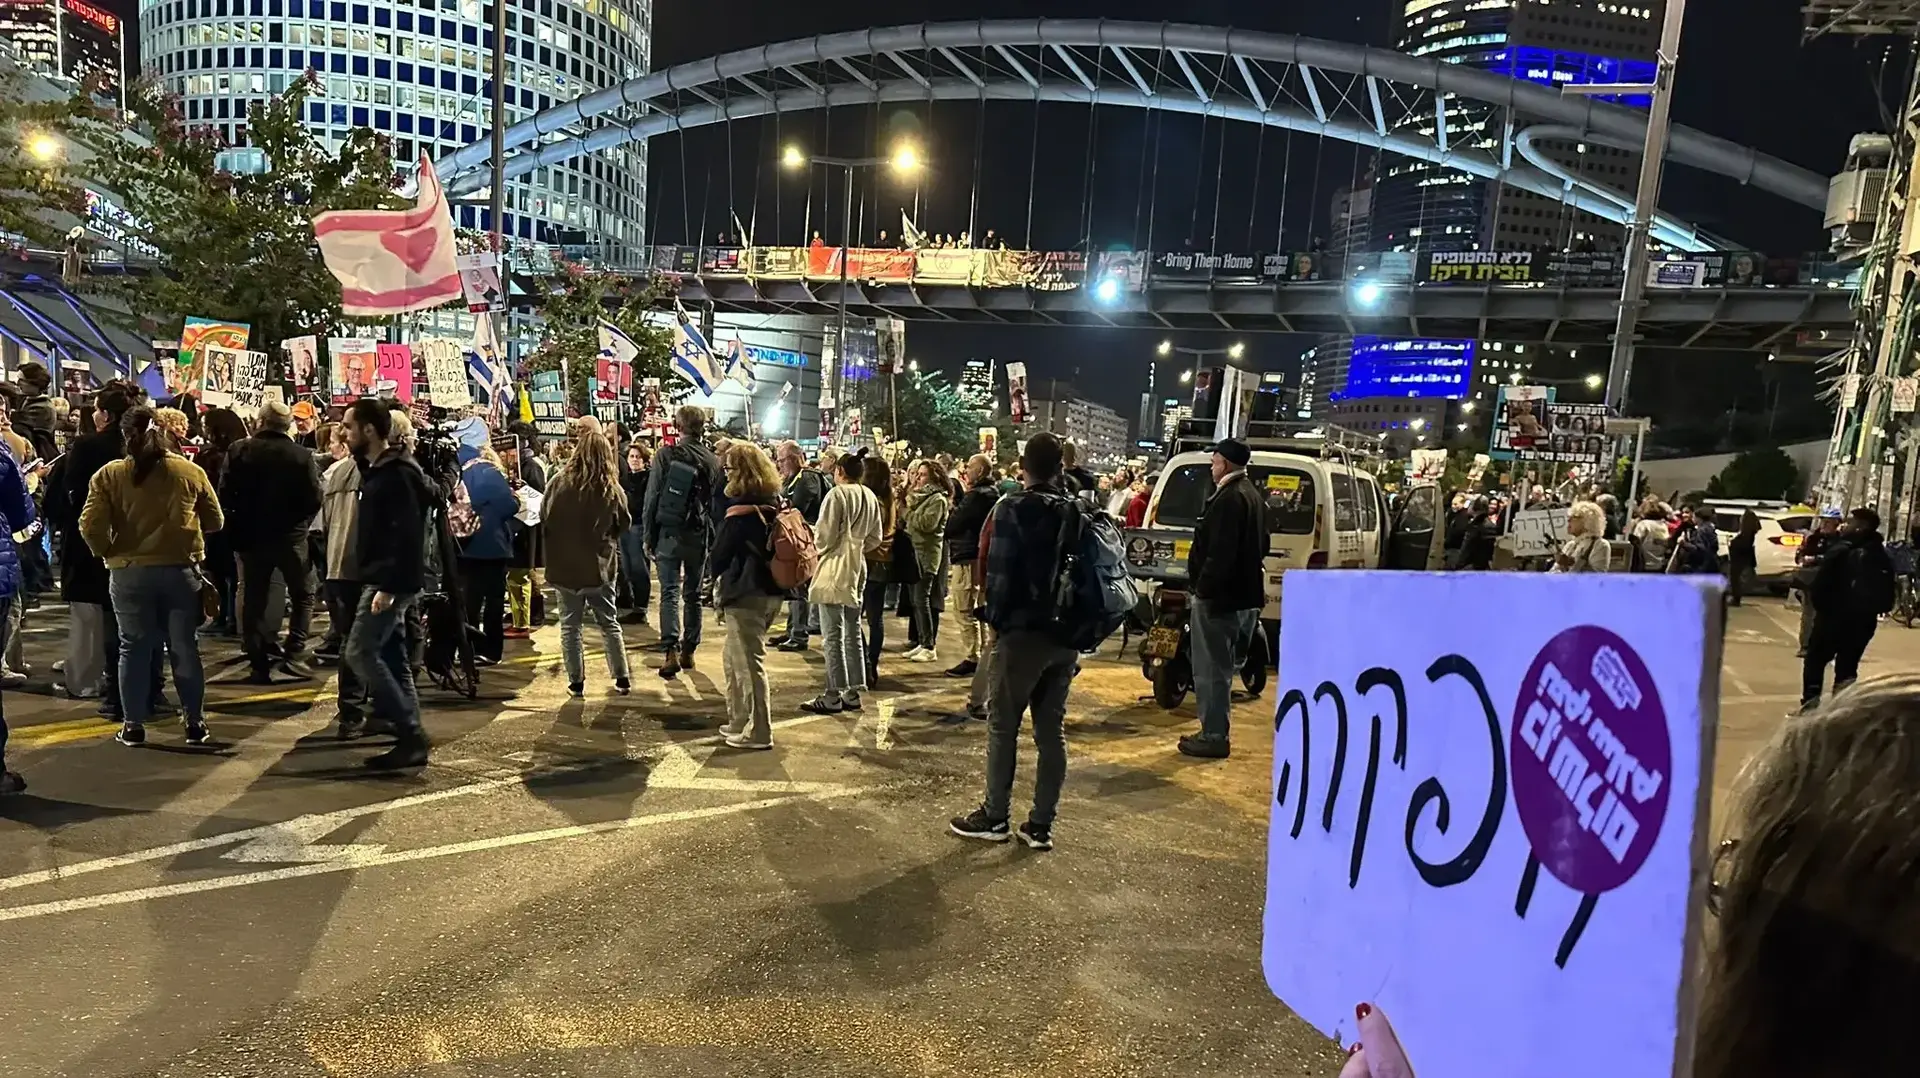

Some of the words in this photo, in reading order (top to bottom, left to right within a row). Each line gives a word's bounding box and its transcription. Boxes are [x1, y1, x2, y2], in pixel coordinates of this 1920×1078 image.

[1165, 252, 1192, 270] Bring
[1194, 252, 1221, 268] Them
[1223, 253, 1253, 269] Home
[1431, 252, 1498, 265] החטופים
[1500, 251, 1532, 264] ללא
[1430, 265, 1472, 283] ריק!
[1476, 265, 1530, 282] הבית
[548, 402, 563, 417] THE
[1548, 736, 1640, 863] שלום
[1275, 654, 1600, 969] פקרה
